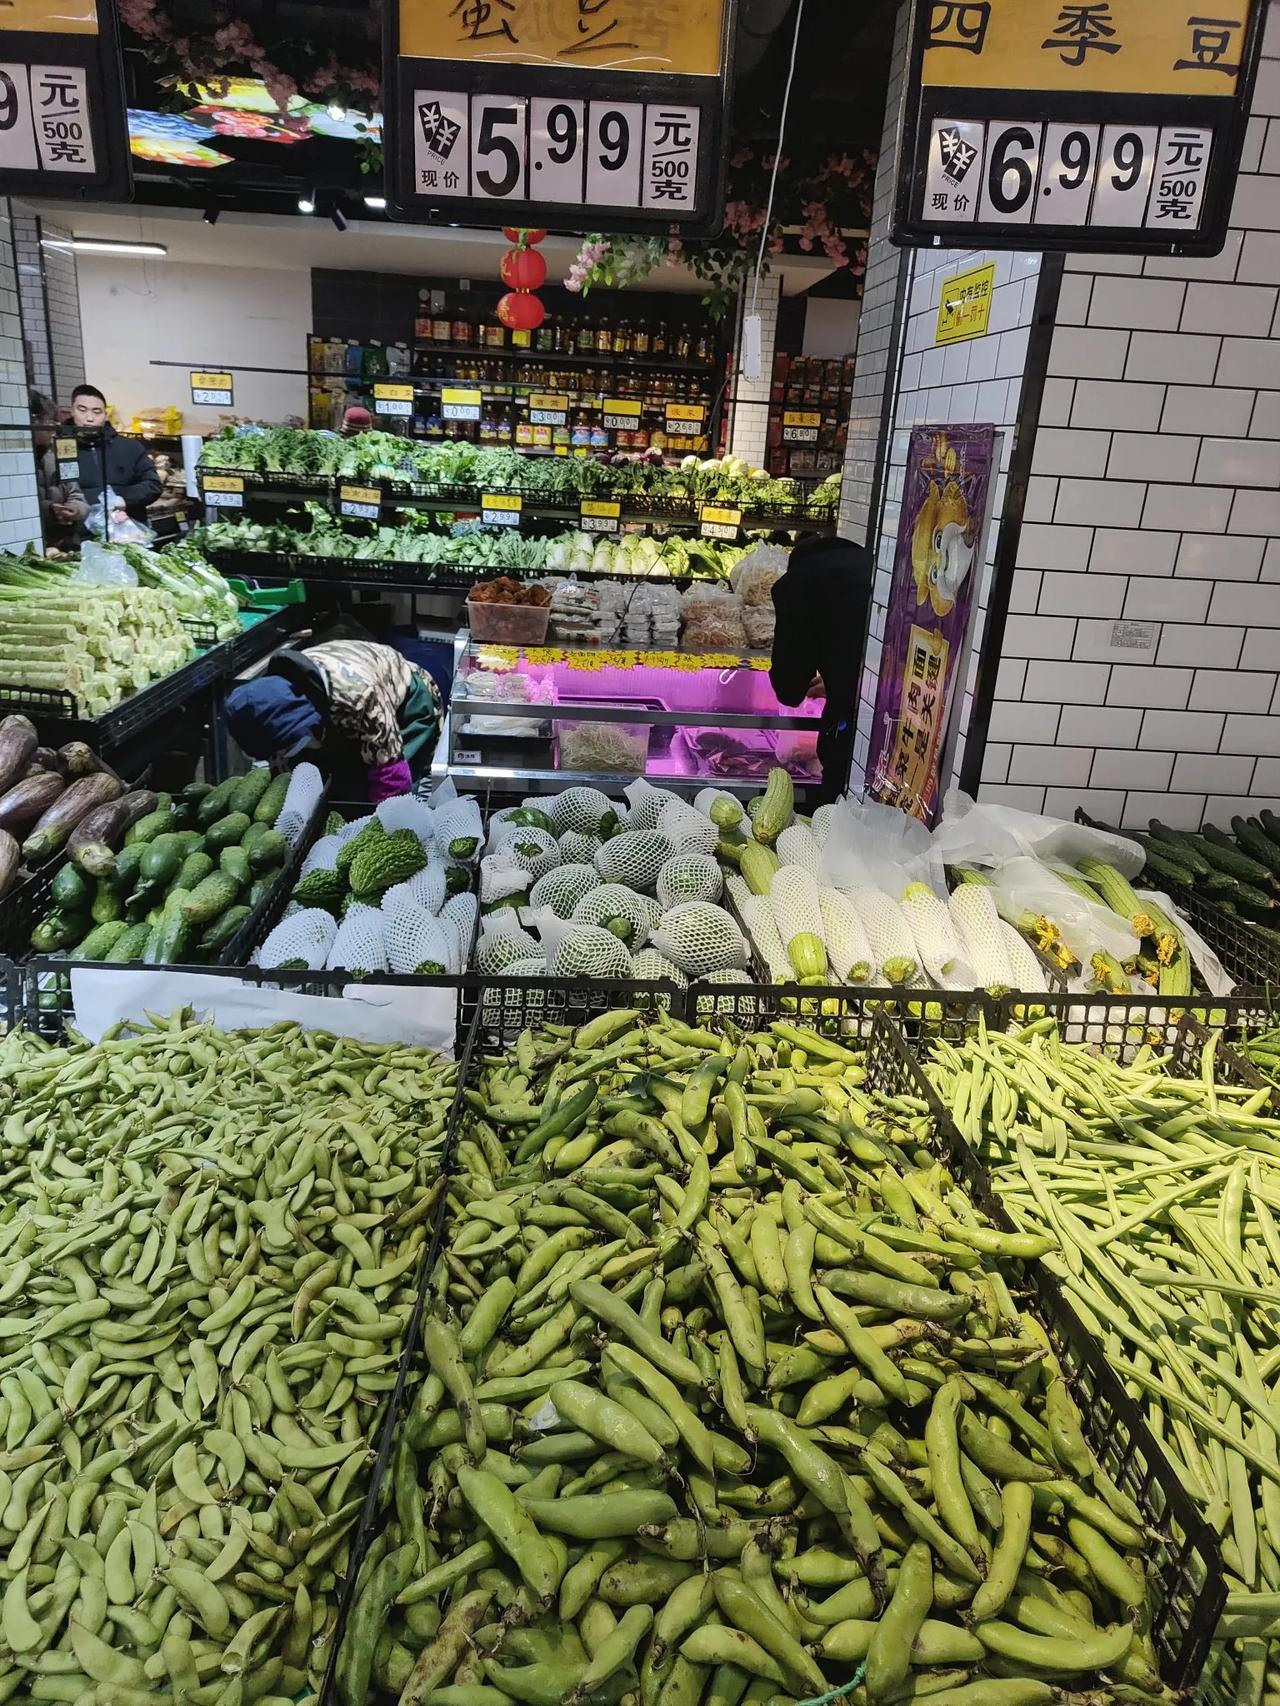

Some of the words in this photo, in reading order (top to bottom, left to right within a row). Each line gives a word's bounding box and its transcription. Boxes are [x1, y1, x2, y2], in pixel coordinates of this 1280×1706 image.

[924, 0, 1241, 77] 四季豆
[43, 121, 83, 140] 500
[45, 140, 88, 164] 克
[475, 104, 630, 197] 5.99
[421, 169, 460, 189] 现价
[651, 160, 690, 178] 500
[988, 126, 1144, 214] 6.99
[650, 179, 688, 201] 克
[940, 173, 960, 189] PRICE
[1158, 180, 1198, 198] 500
[931, 193, 970, 212] 现价
[1154, 198, 1194, 220] 克
